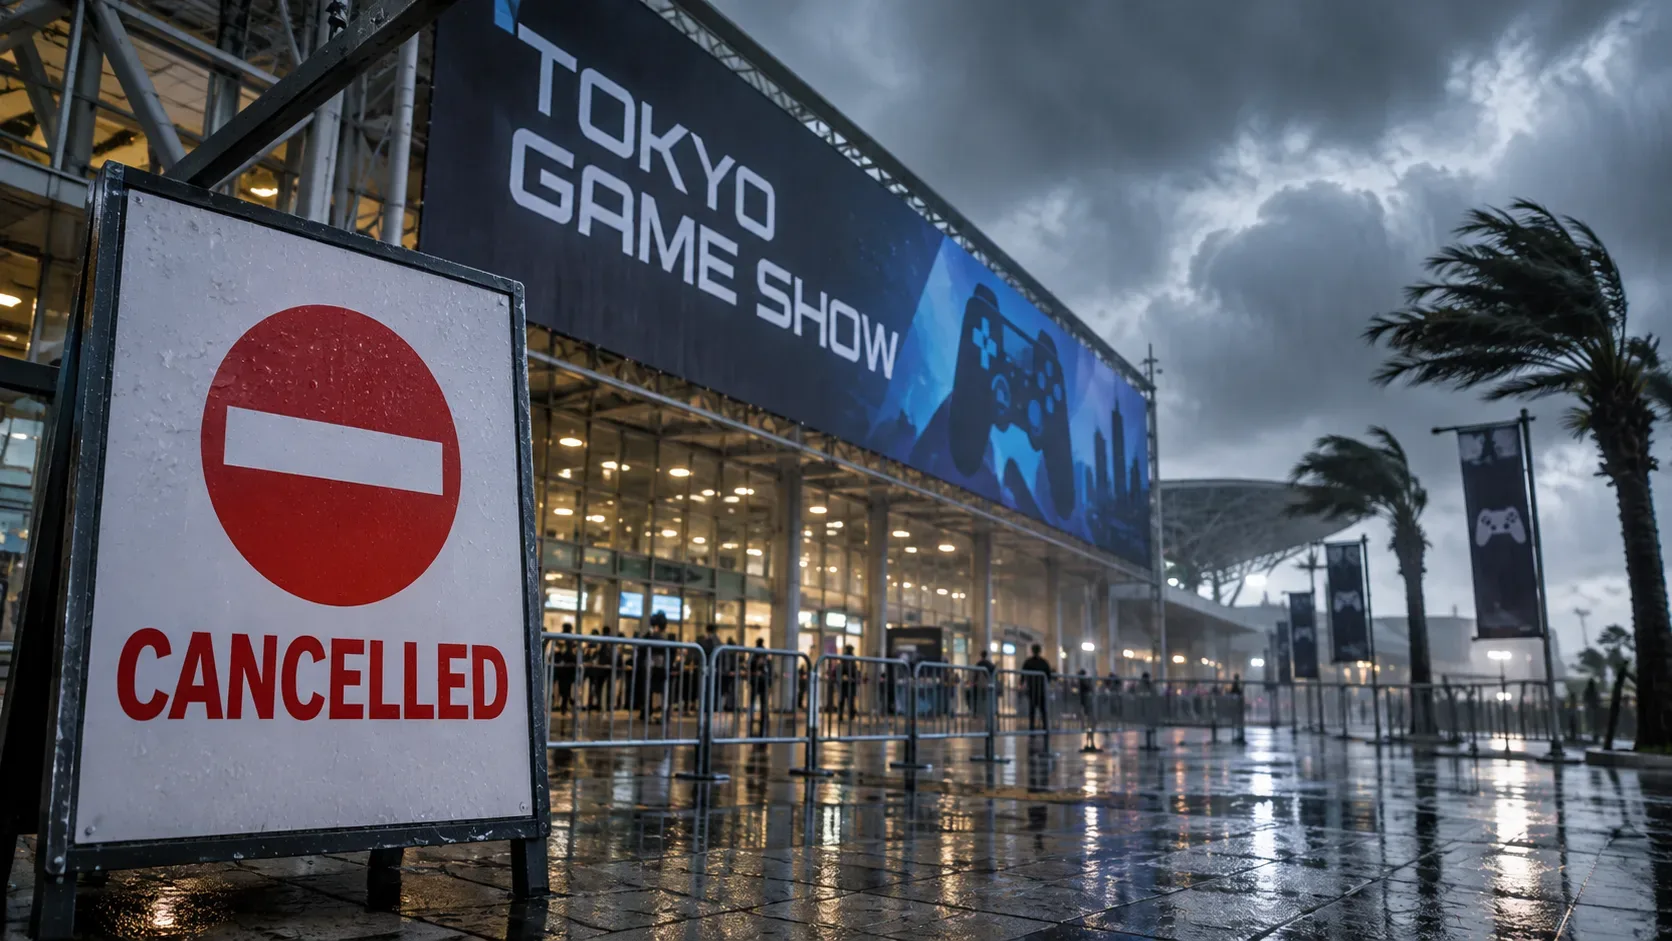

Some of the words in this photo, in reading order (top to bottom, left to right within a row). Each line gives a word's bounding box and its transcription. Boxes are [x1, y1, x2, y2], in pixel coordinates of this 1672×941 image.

[518, 24, 776, 241] TOKYO
[510, 128, 738, 305] GAME
[757, 259, 899, 380] SHOW
[117, 627, 508, 721] CANCELLED
